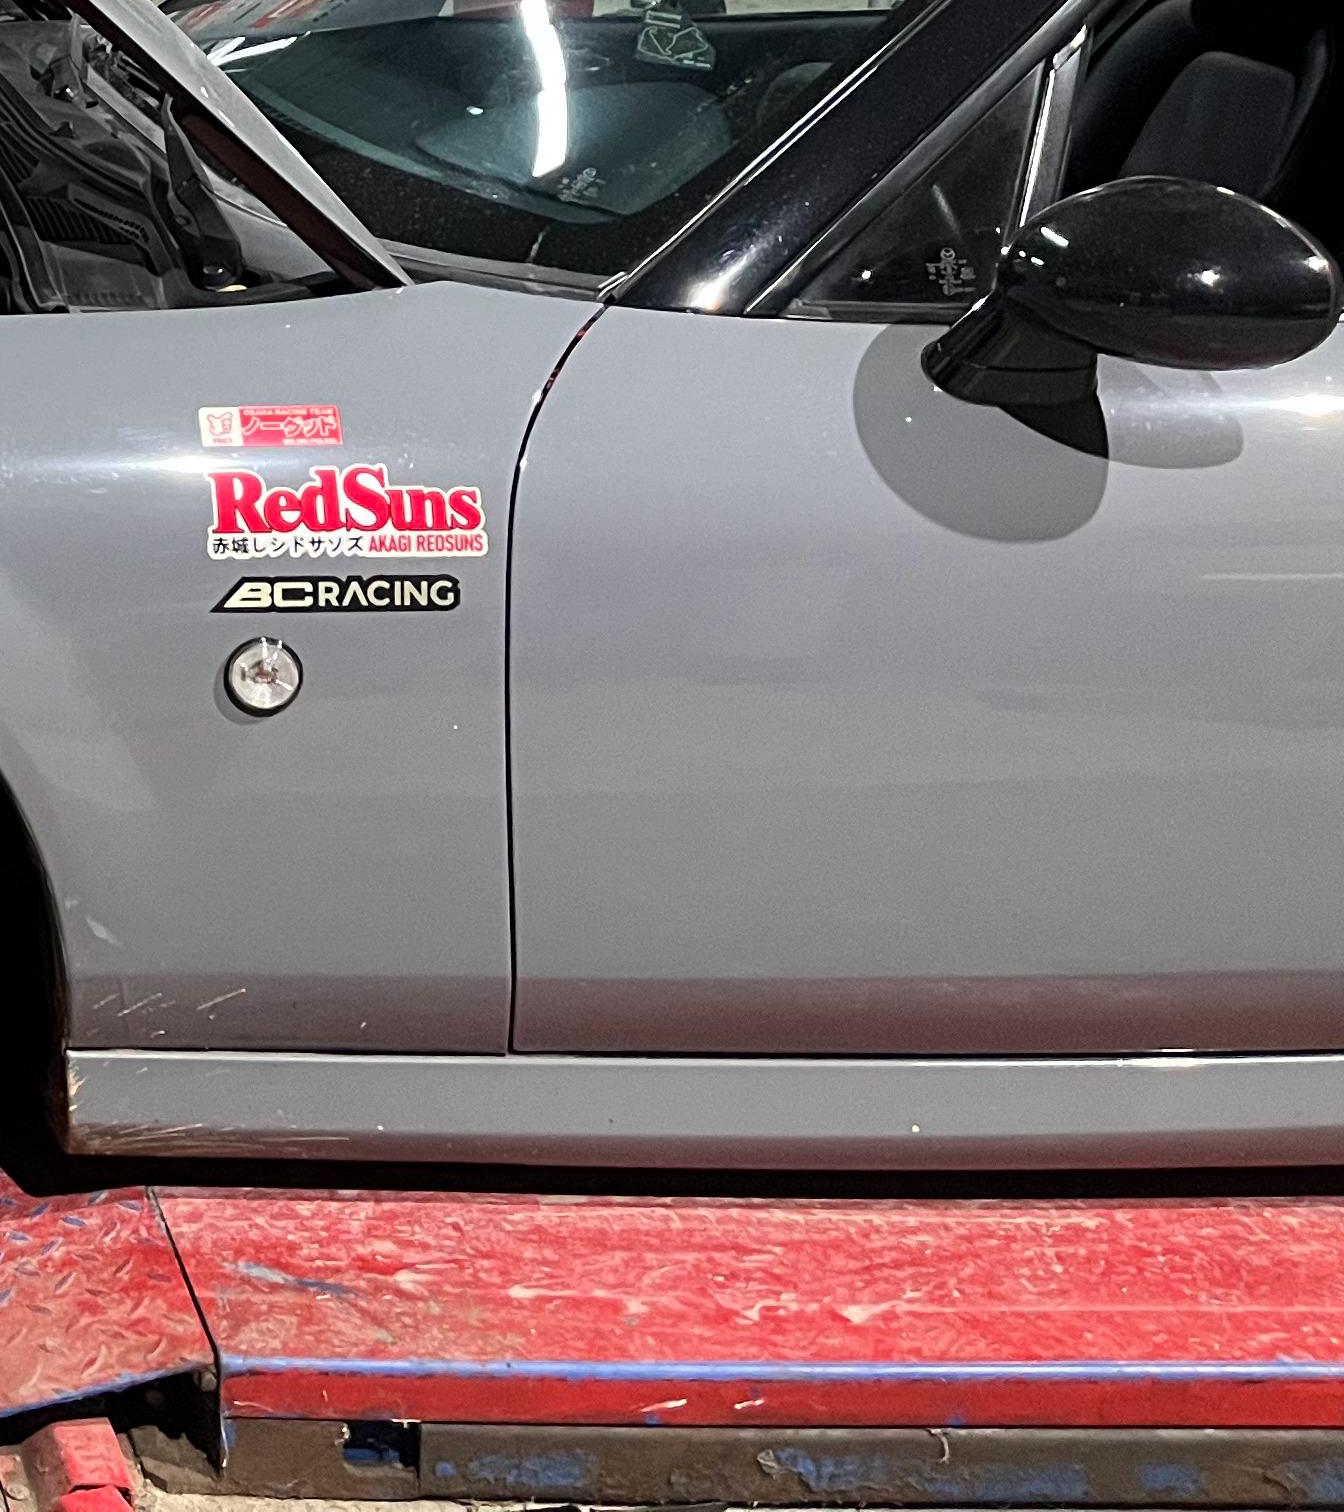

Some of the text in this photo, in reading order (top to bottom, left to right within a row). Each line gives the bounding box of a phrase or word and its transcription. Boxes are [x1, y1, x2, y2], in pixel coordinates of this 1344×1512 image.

[212, 467, 481, 534] RedSuns
[368, 534, 483, 552] AKAGI REDSUNS
[318, 579, 455, 608] RACING
